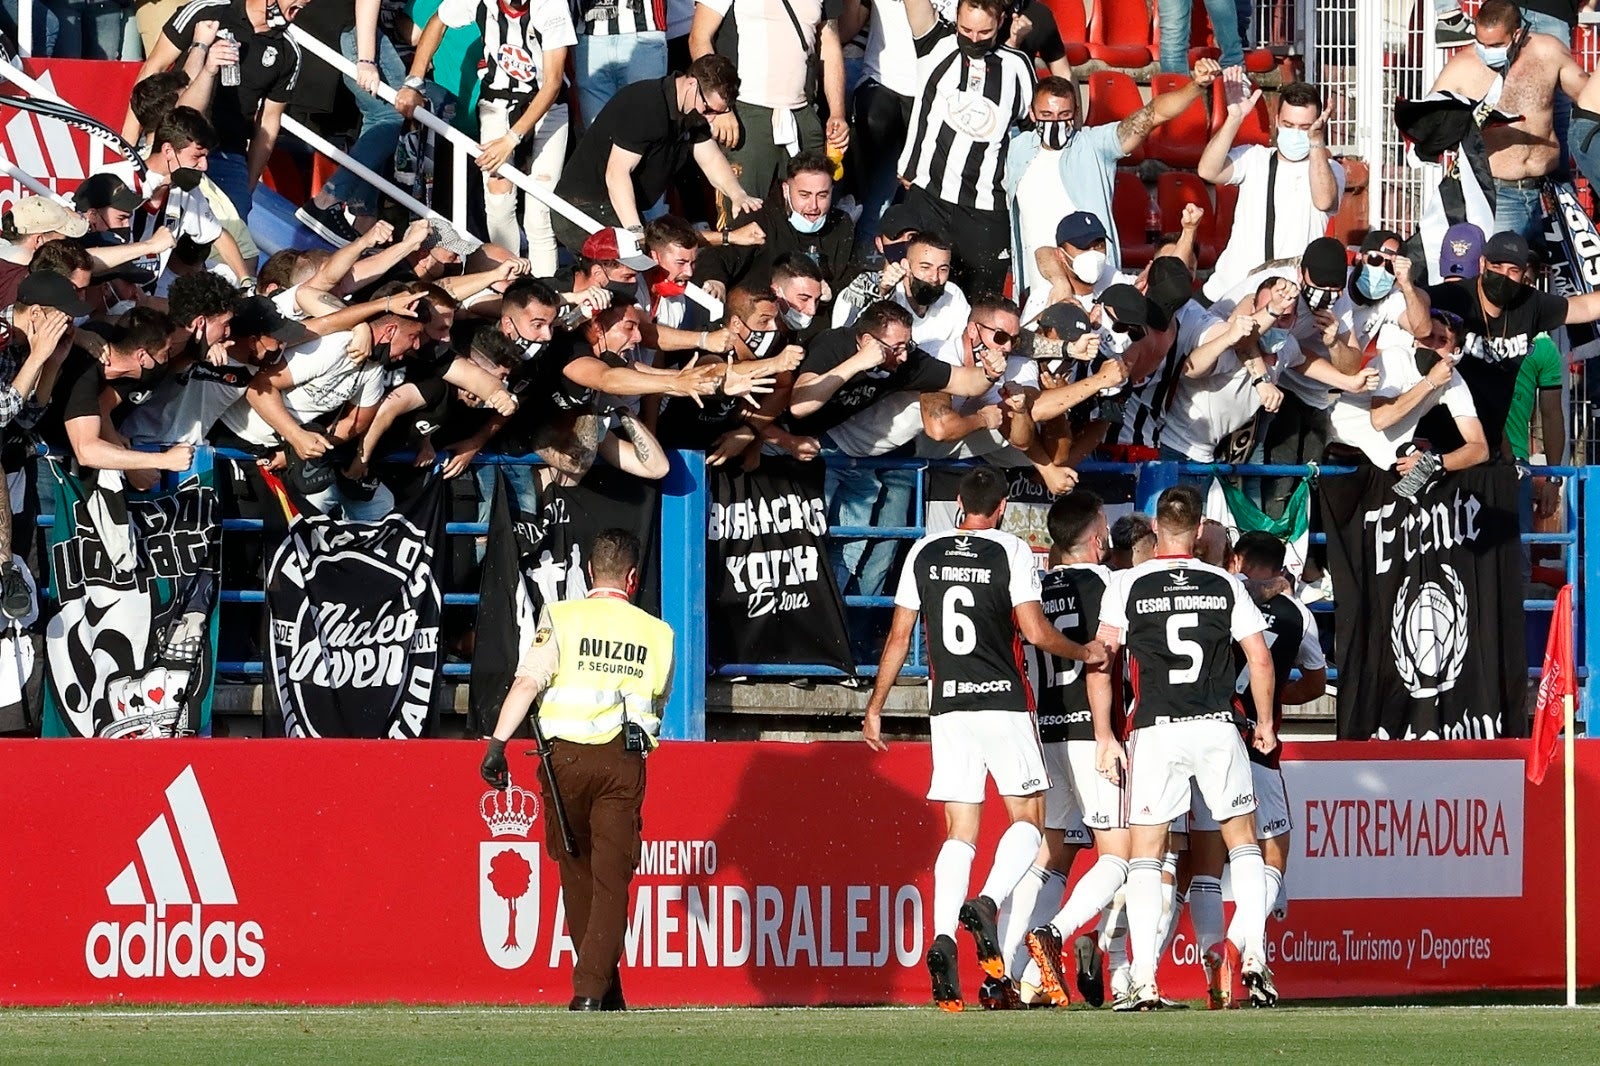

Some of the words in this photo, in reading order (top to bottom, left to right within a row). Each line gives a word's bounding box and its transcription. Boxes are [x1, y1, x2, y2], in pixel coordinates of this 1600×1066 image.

[1364, 487, 1481, 575] Frente
[726, 545, 818, 593] YOUTH
[929, 565, 940, 580] S.
[942, 566, 992, 584] MAESTRE
[942, 585, 977, 656] 6
[1136, 598, 1171, 614] CESAR
[1174, 596, 1228, 611] MORGADO
[579, 637, 648, 665] AVIZOR
[589, 661, 644, 679] SEGURIDAD
[1166, 613, 1204, 685] 5
[1305, 798, 1509, 858] EXTREMADURA
[635, 841, 717, 875] MIENTO
[85, 903, 266, 978] adidas
[549, 884, 924, 968] AMENDRALEJO
[1281, 931, 1341, 966] Cultura,
[1342, 930, 1401, 961] Turismo
[1407, 938, 1416, 969] y
[1421, 928, 1491, 969] Deportes
